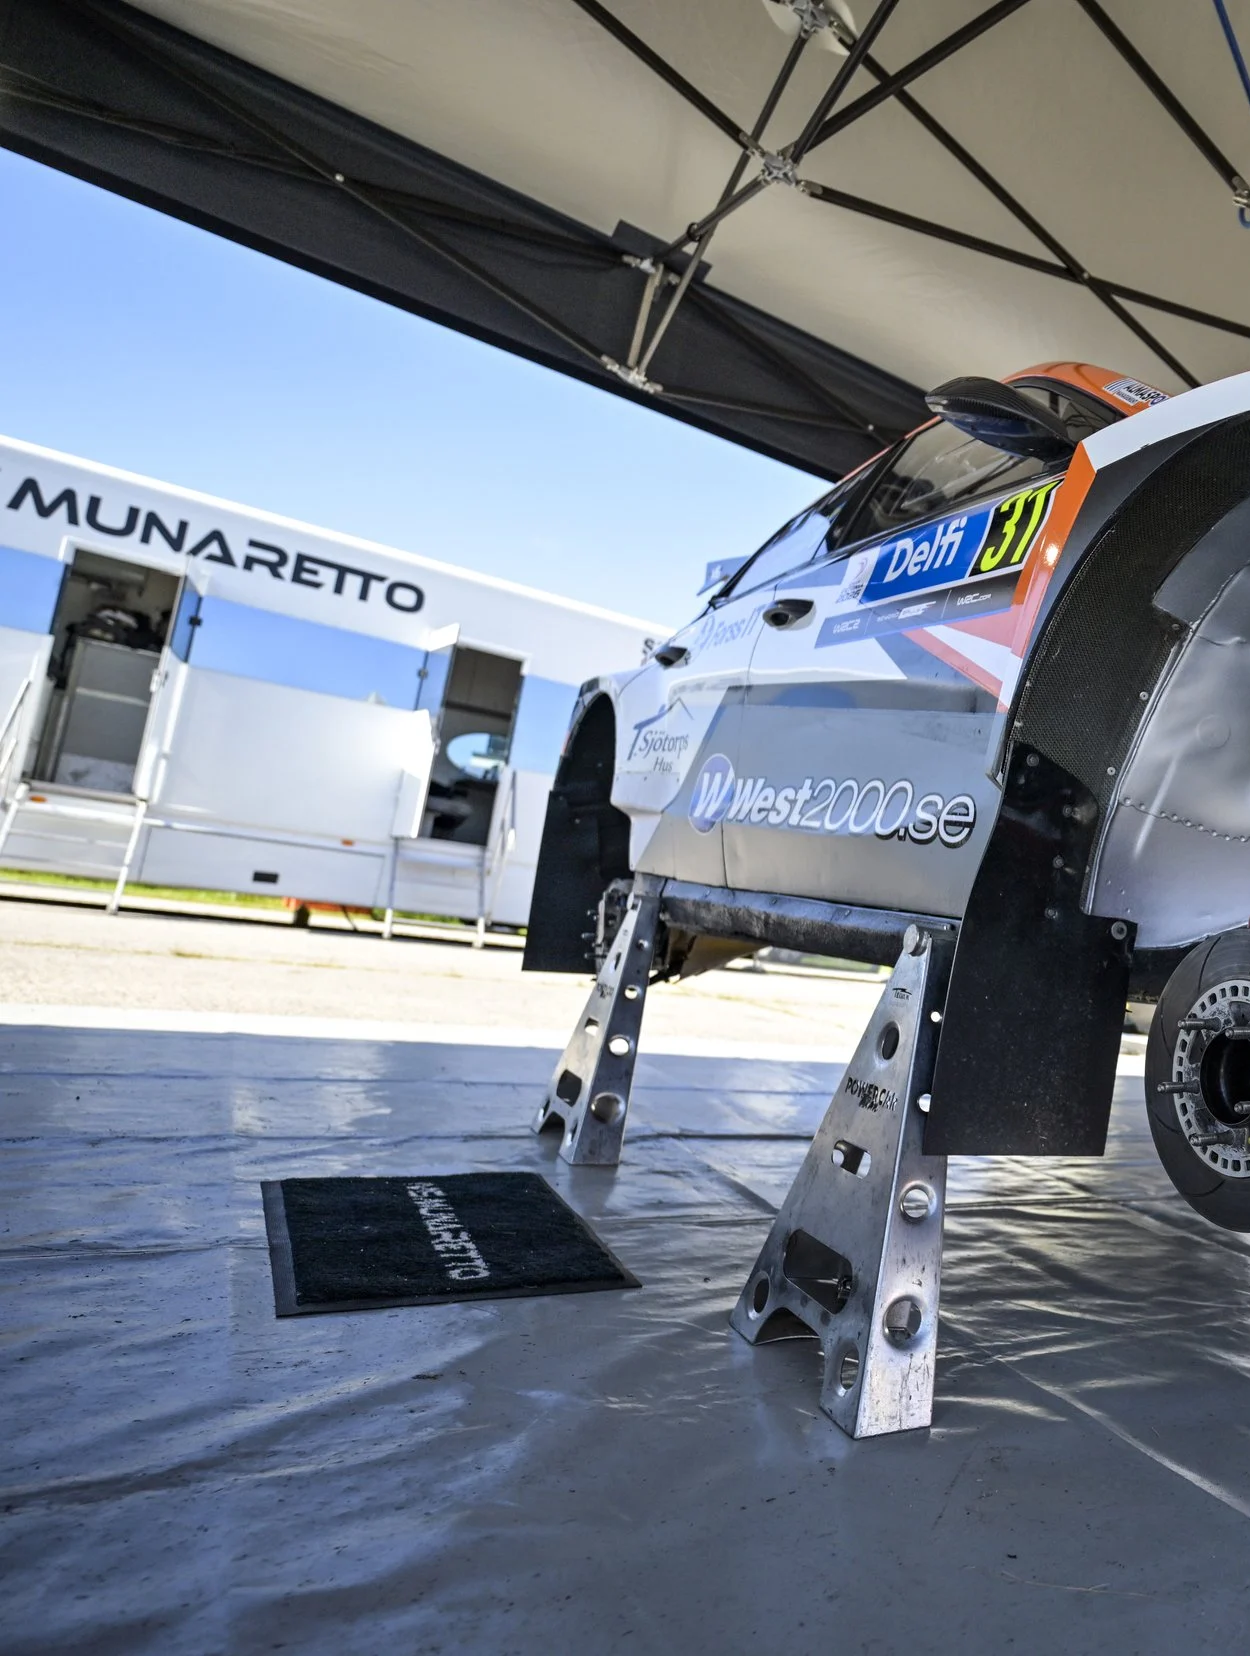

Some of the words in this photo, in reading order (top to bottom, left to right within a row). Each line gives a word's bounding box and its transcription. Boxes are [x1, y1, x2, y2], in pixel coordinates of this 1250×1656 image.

[7, 477, 426, 614] MUNARETTO
[883, 516, 968, 583] Delfi
[980, 481, 1060, 572] 31
[652, 756, 673, 773] Hus
[727, 777, 977, 849] West2000.se
